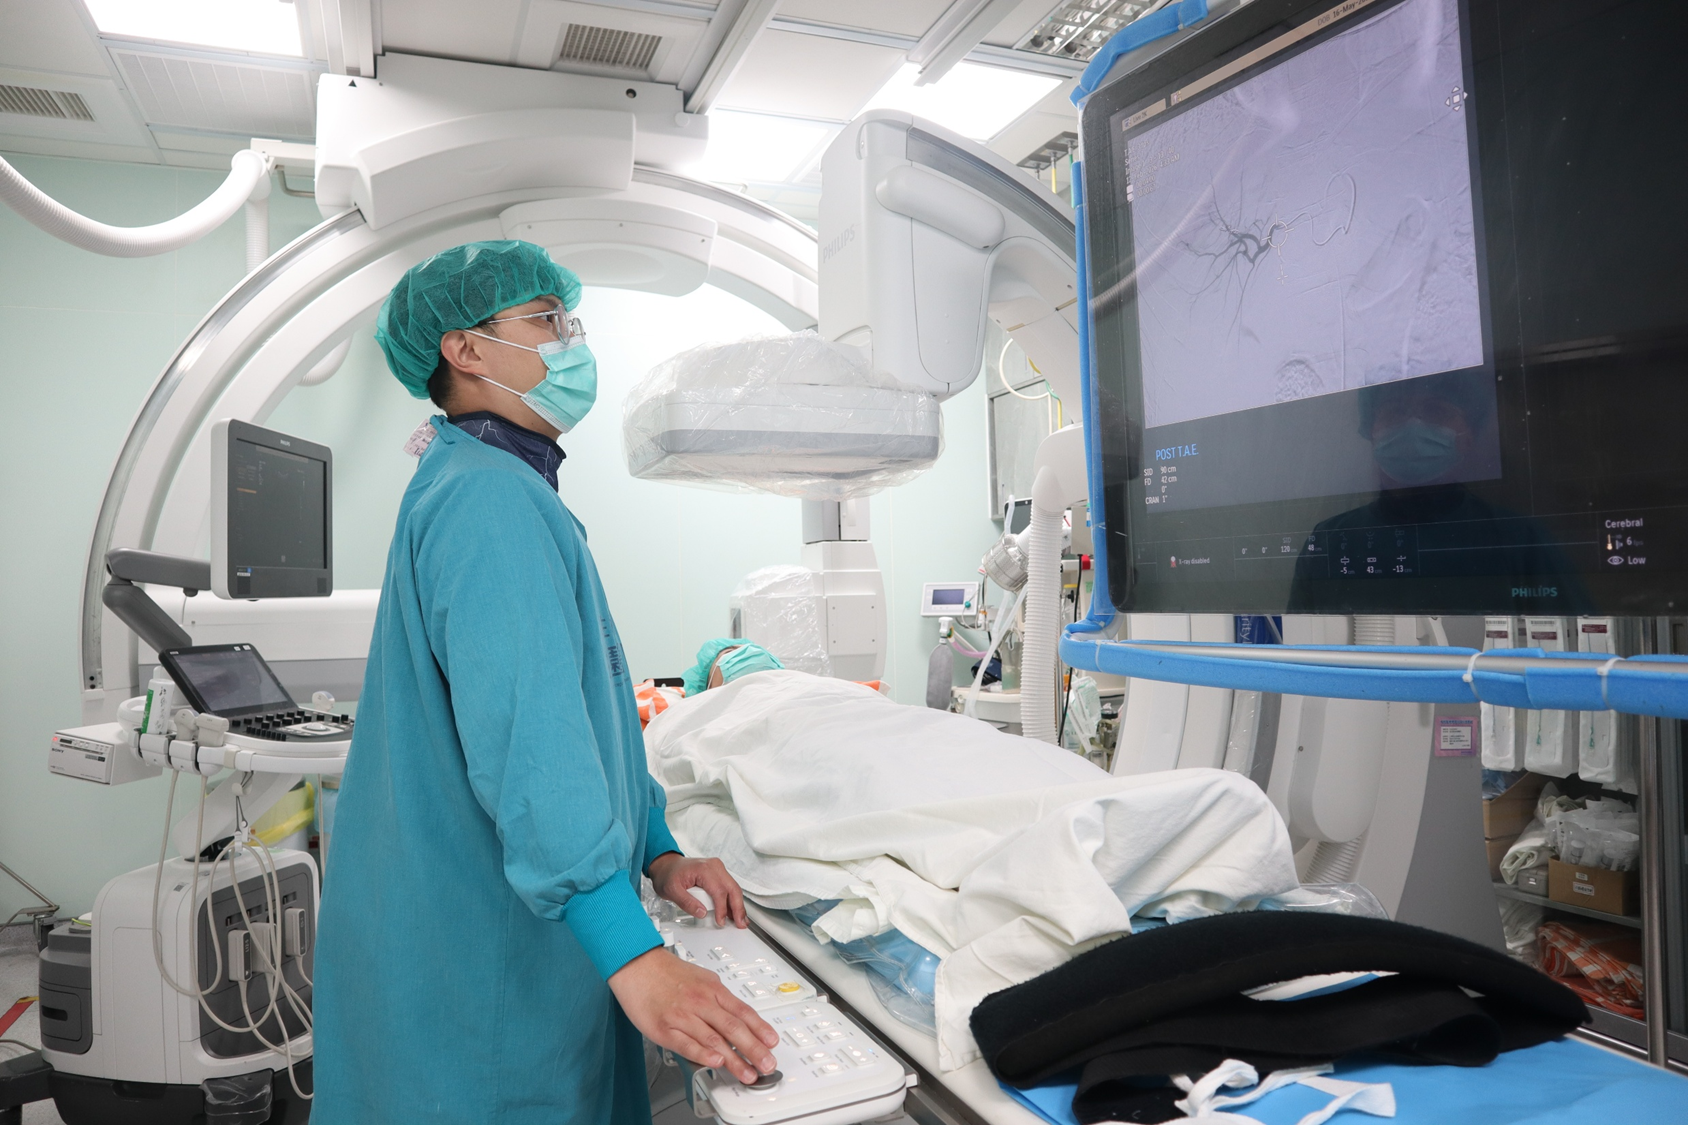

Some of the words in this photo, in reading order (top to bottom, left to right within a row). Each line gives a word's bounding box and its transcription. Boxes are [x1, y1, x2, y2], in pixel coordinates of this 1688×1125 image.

[823, 223, 855, 264] PHILIPS
[1155, 447, 1176, 461] POST
[1143, 467, 1153, 476] SID
[1144, 478, 1152, 486] FD
[1145, 496, 1159, 504] CRAN
[1605, 518, 1643, 529] Cerebral
[1626, 536, 1633, 546] 6
[1280, 545, 1291, 553] 120
[1178, 558, 1190, 566] X-ray
[1627, 556, 1646, 565] Low
[1340, 566, 1348, 574] -5
[1366, 565, 1375, 573] 43
[1392, 564, 1404, 573] -13
[1511, 587, 1558, 597] PHILIPS
